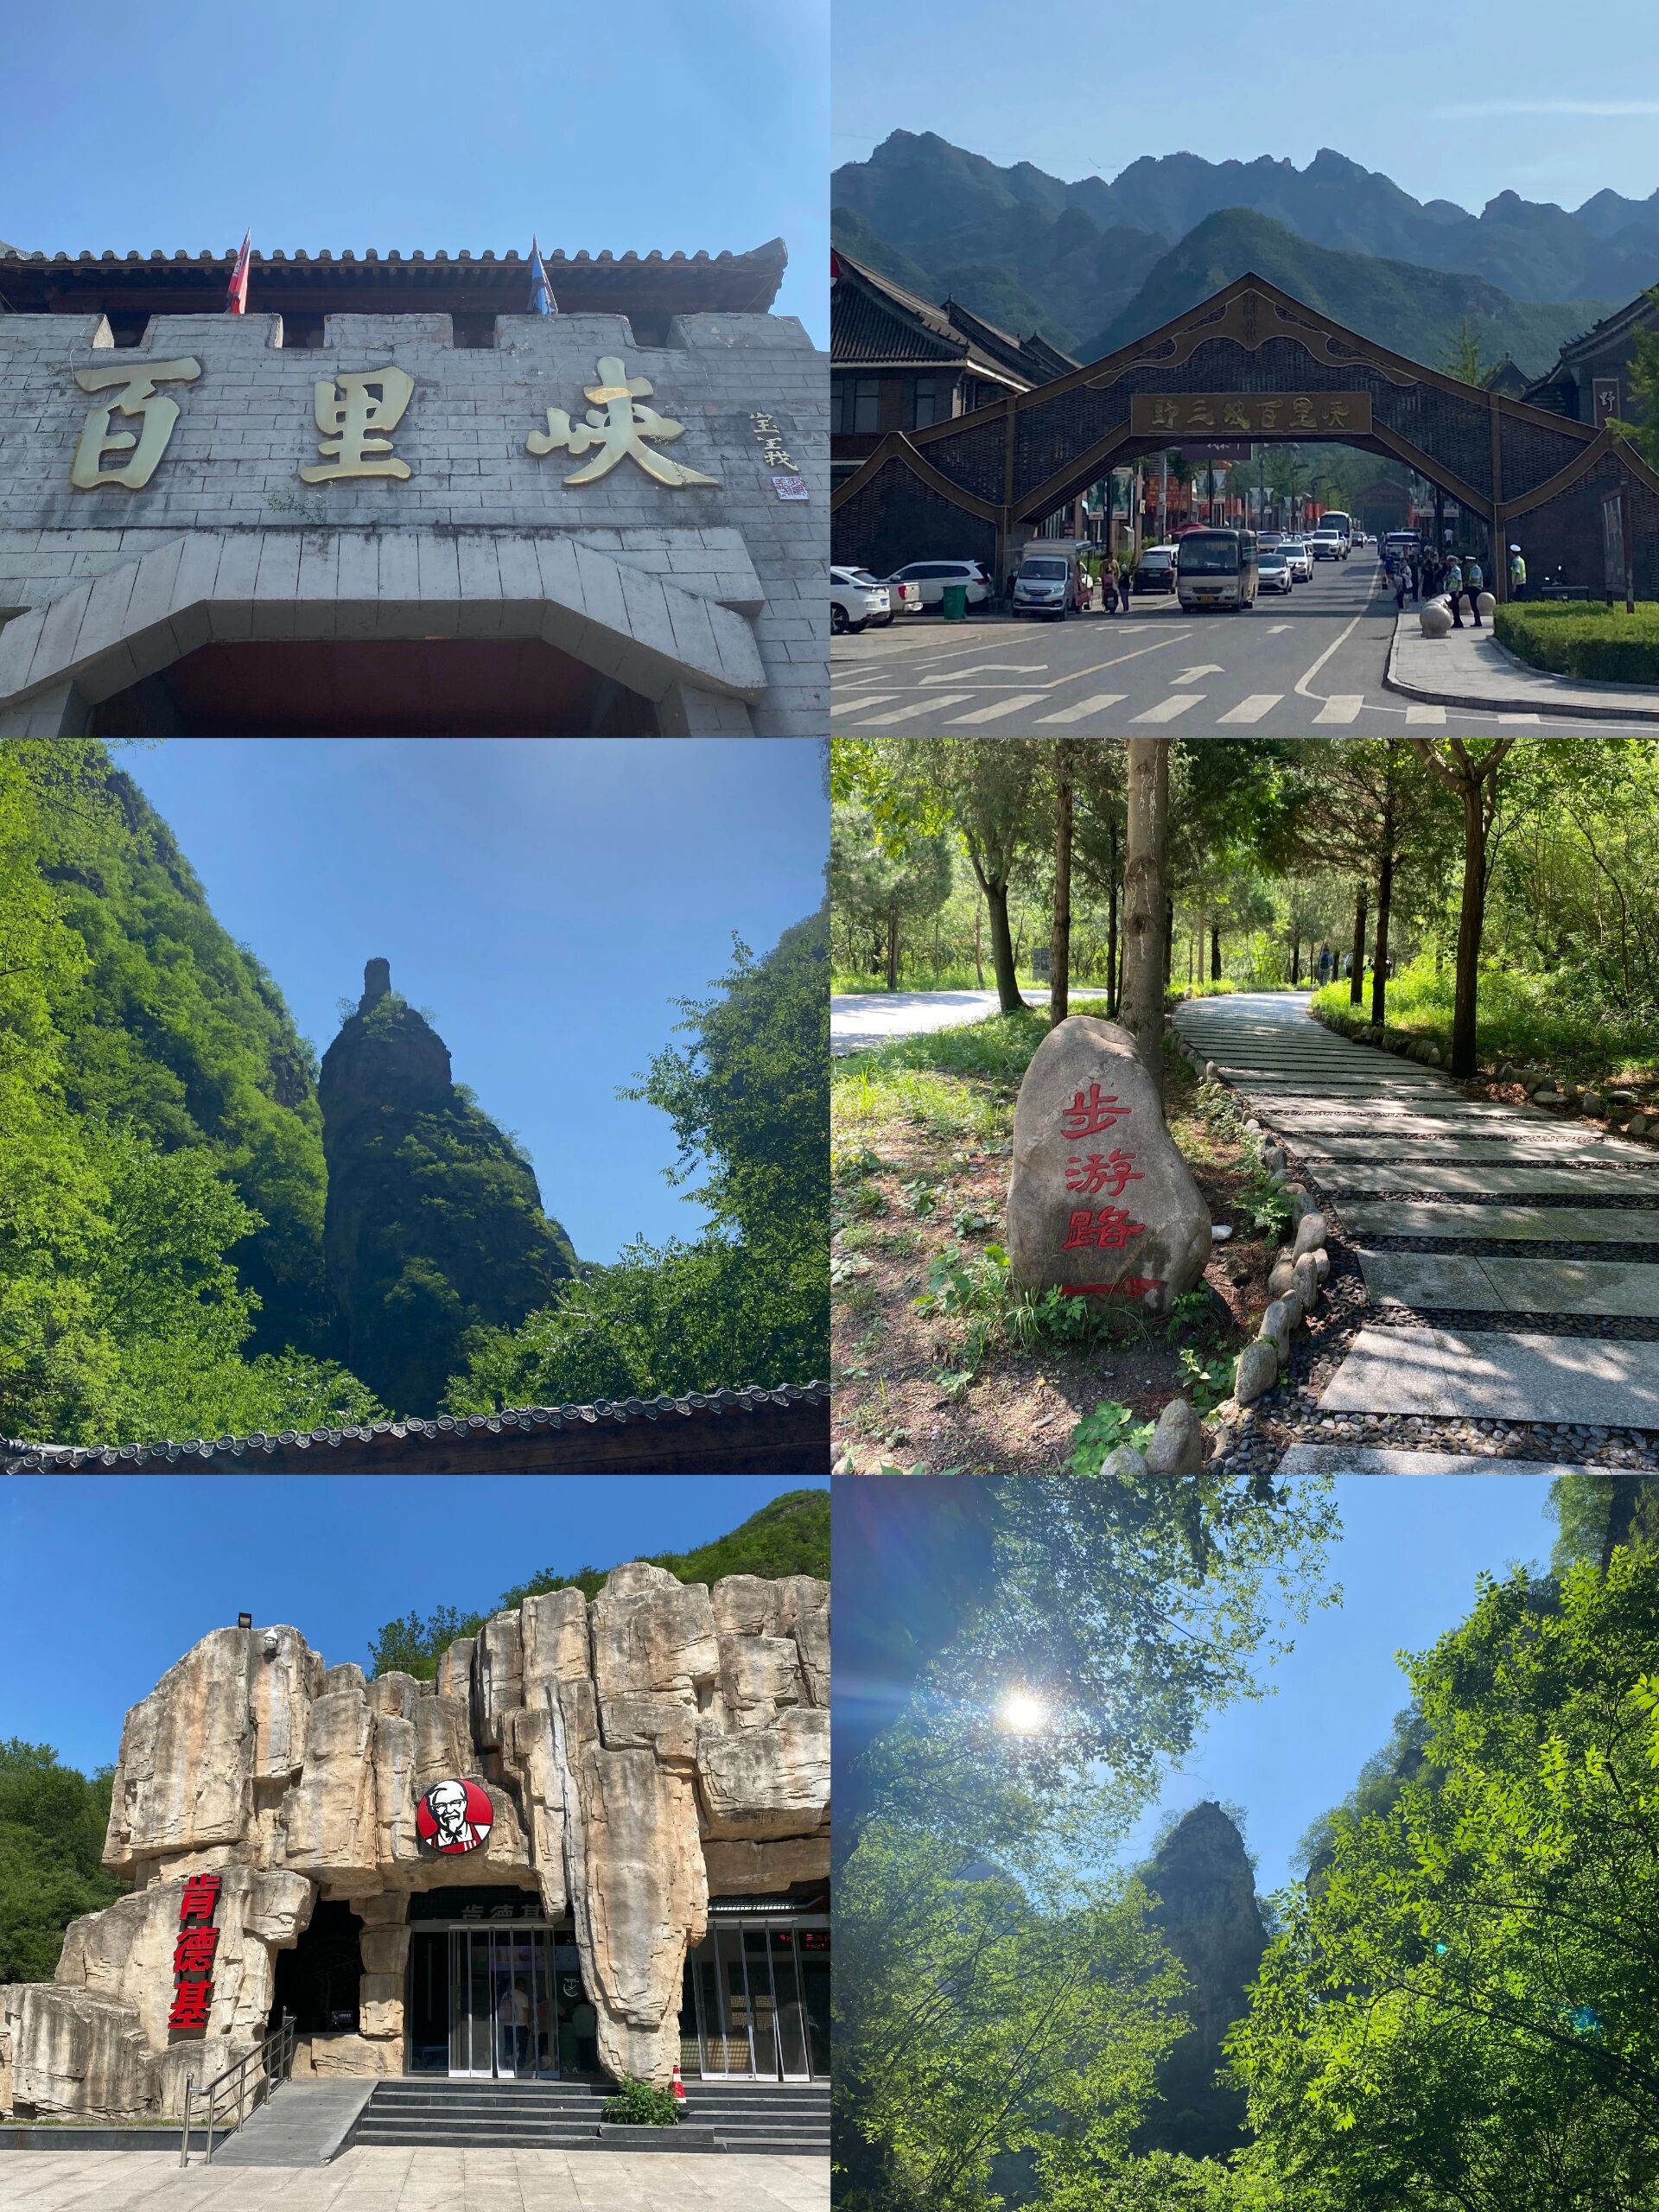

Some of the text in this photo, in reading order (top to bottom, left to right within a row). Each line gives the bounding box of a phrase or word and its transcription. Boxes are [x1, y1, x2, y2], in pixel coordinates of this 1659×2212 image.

[71, 356, 722, 491] 百里峡
[1060, 1083, 1147, 1251] 步游路
[168, 1873, 222, 2029] 肯德基
